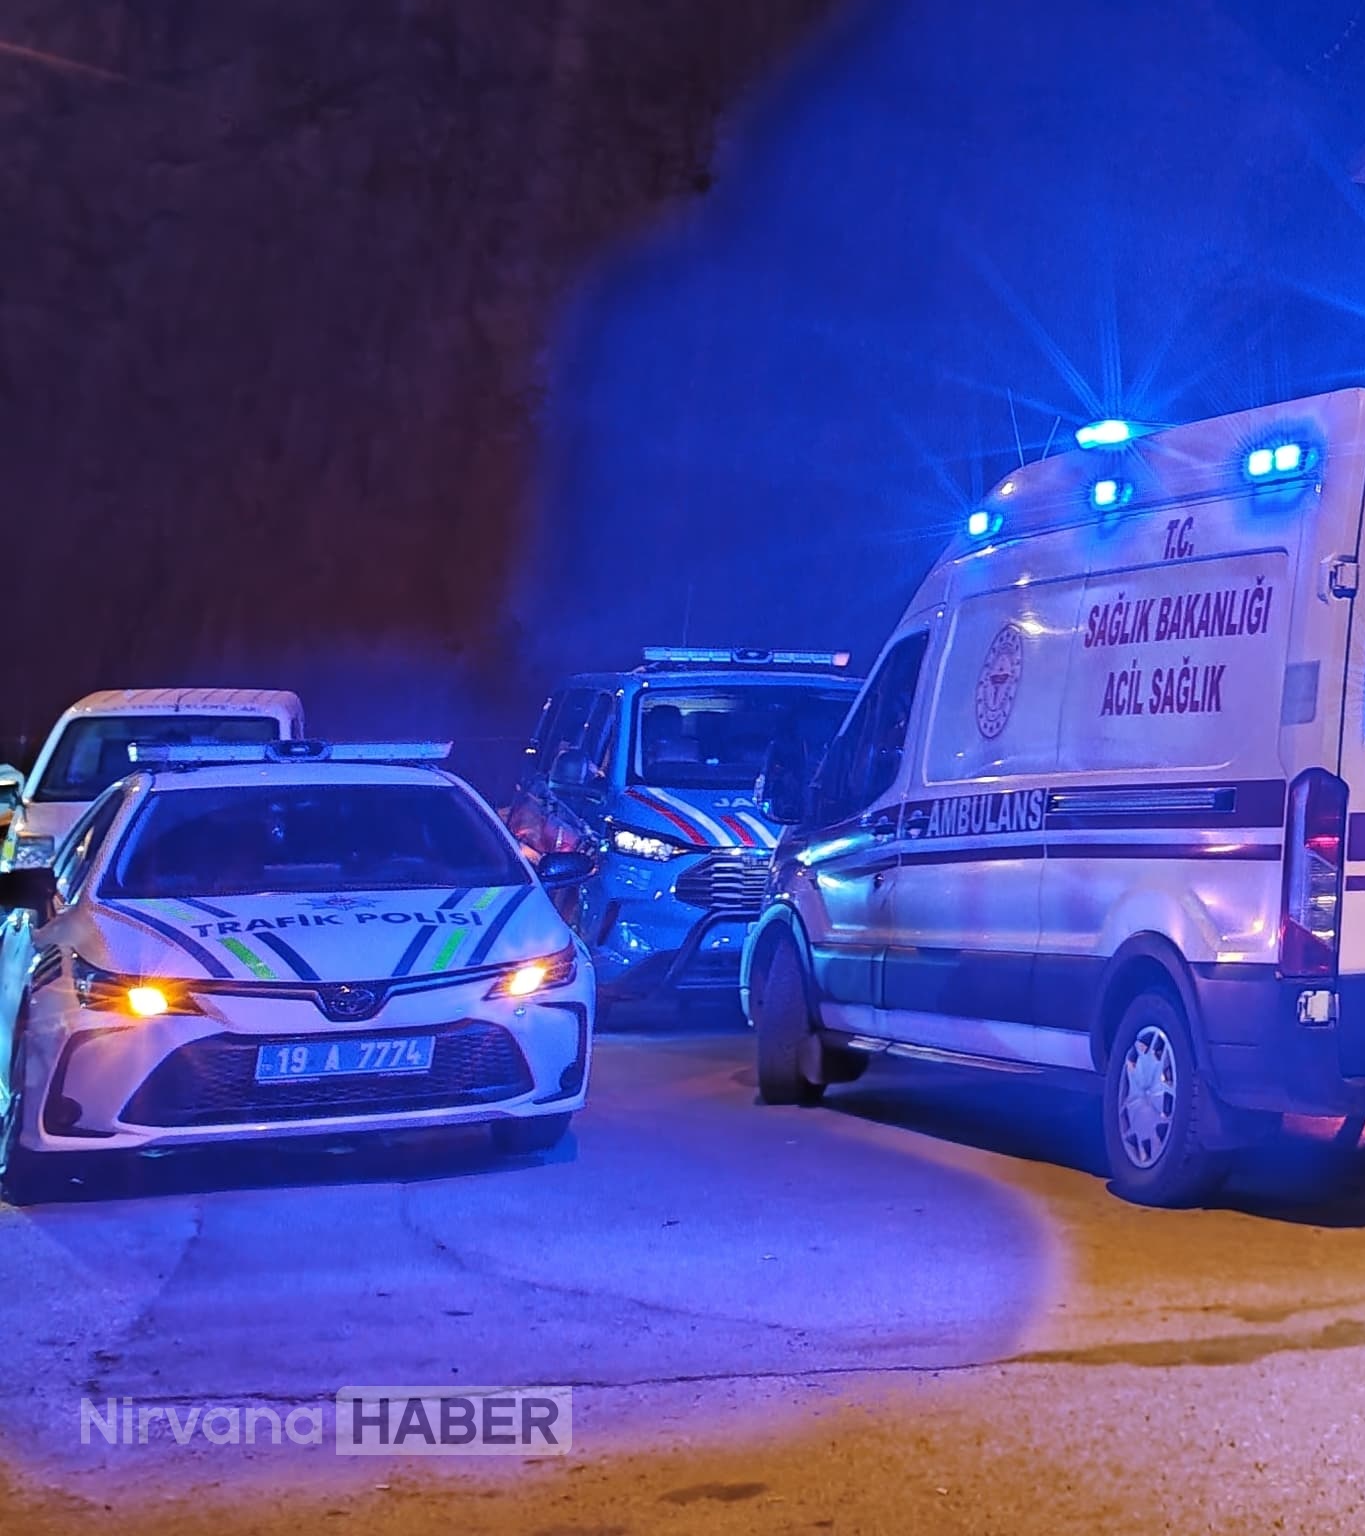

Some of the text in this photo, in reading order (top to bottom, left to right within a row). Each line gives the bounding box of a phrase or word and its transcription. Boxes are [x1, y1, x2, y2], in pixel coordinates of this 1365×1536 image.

[1164, 516, 1195, 560] T.C.
[1084, 574, 1273, 649] SAĞLIK BAKANLIĞI
[1100, 655, 1227, 716] ACİL SAĞLIK
[926, 789, 1043, 837] AMBULANS
[192, 910, 483, 938] TRAFİK POLİSİ
[278, 1040, 421, 1074] 19 A 7774
